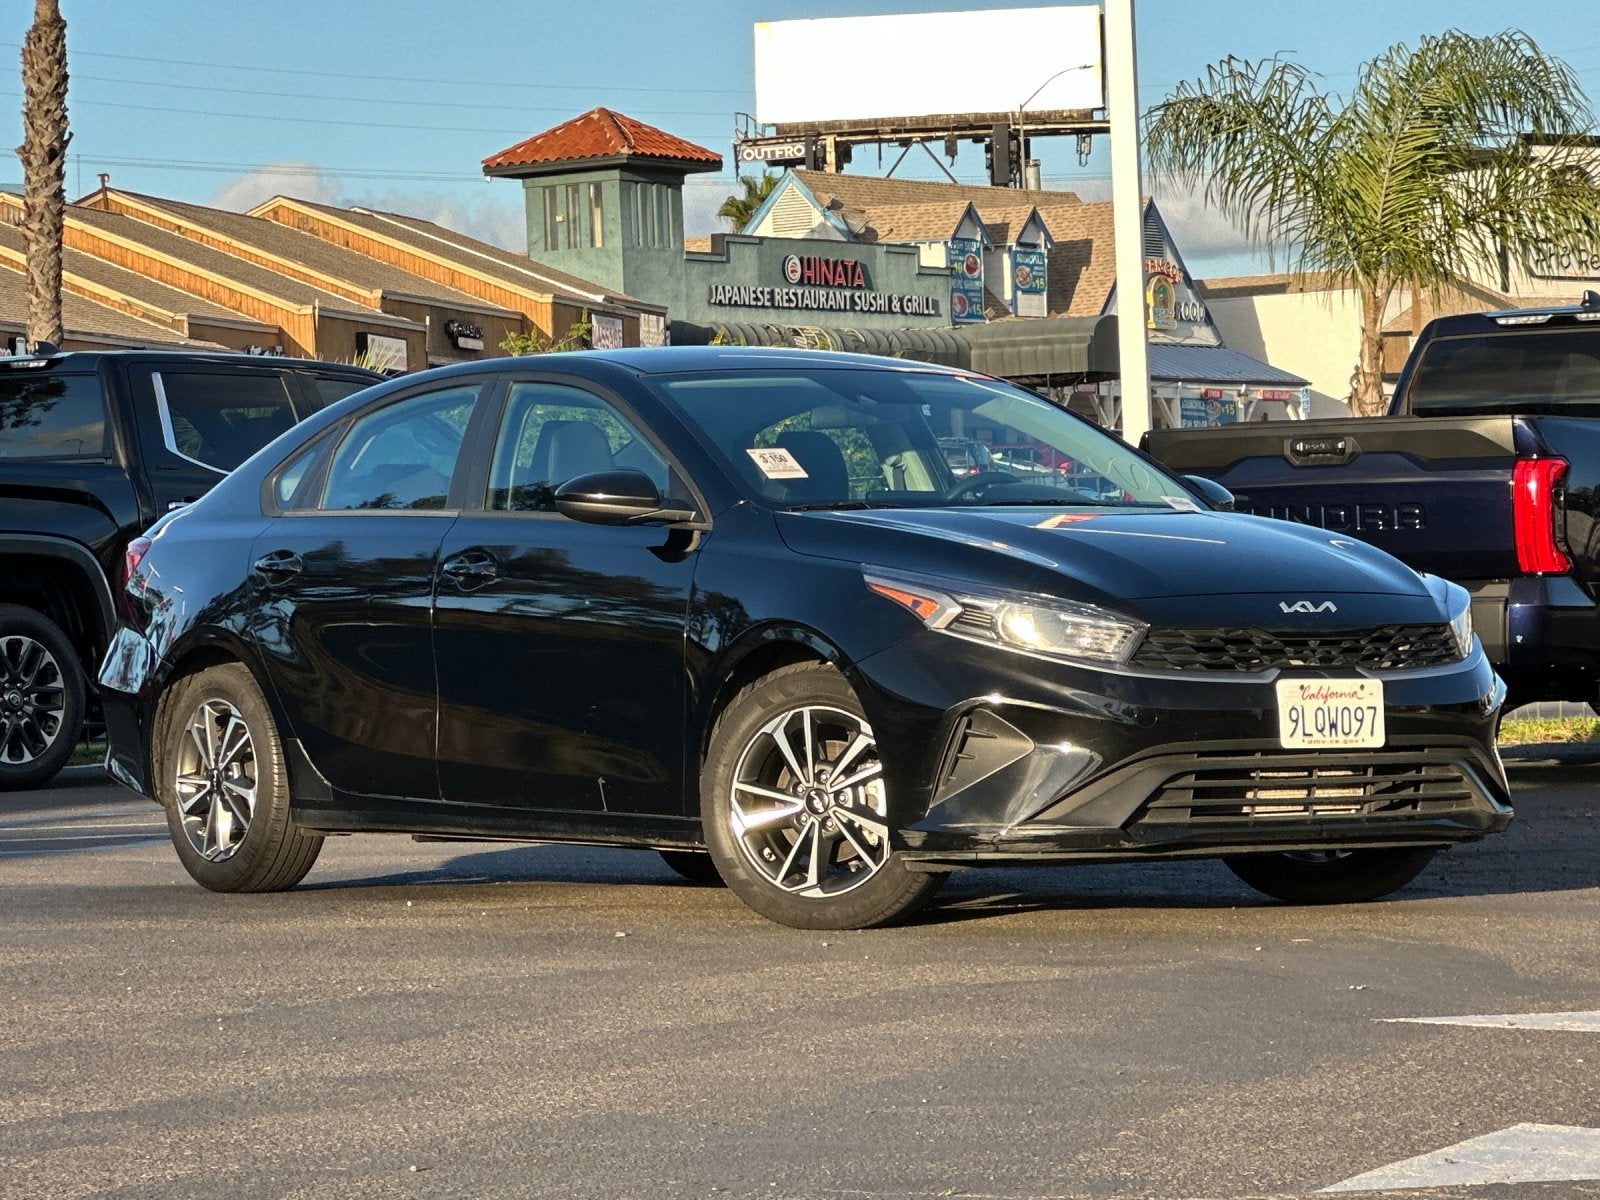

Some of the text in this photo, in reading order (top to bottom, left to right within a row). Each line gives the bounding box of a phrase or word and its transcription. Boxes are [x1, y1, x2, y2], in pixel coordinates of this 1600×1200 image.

[743, 145, 806, 161] OUTFRO
[802, 257, 865, 288] HINATA
[710, 285, 935, 315] JAPANESE RESTAURANT SUSHI & GRILL
[1279, 600, 1337, 613] KIA
[1301, 684, 1366, 705] California
[1288, 706, 1378, 738] 9LQW097
